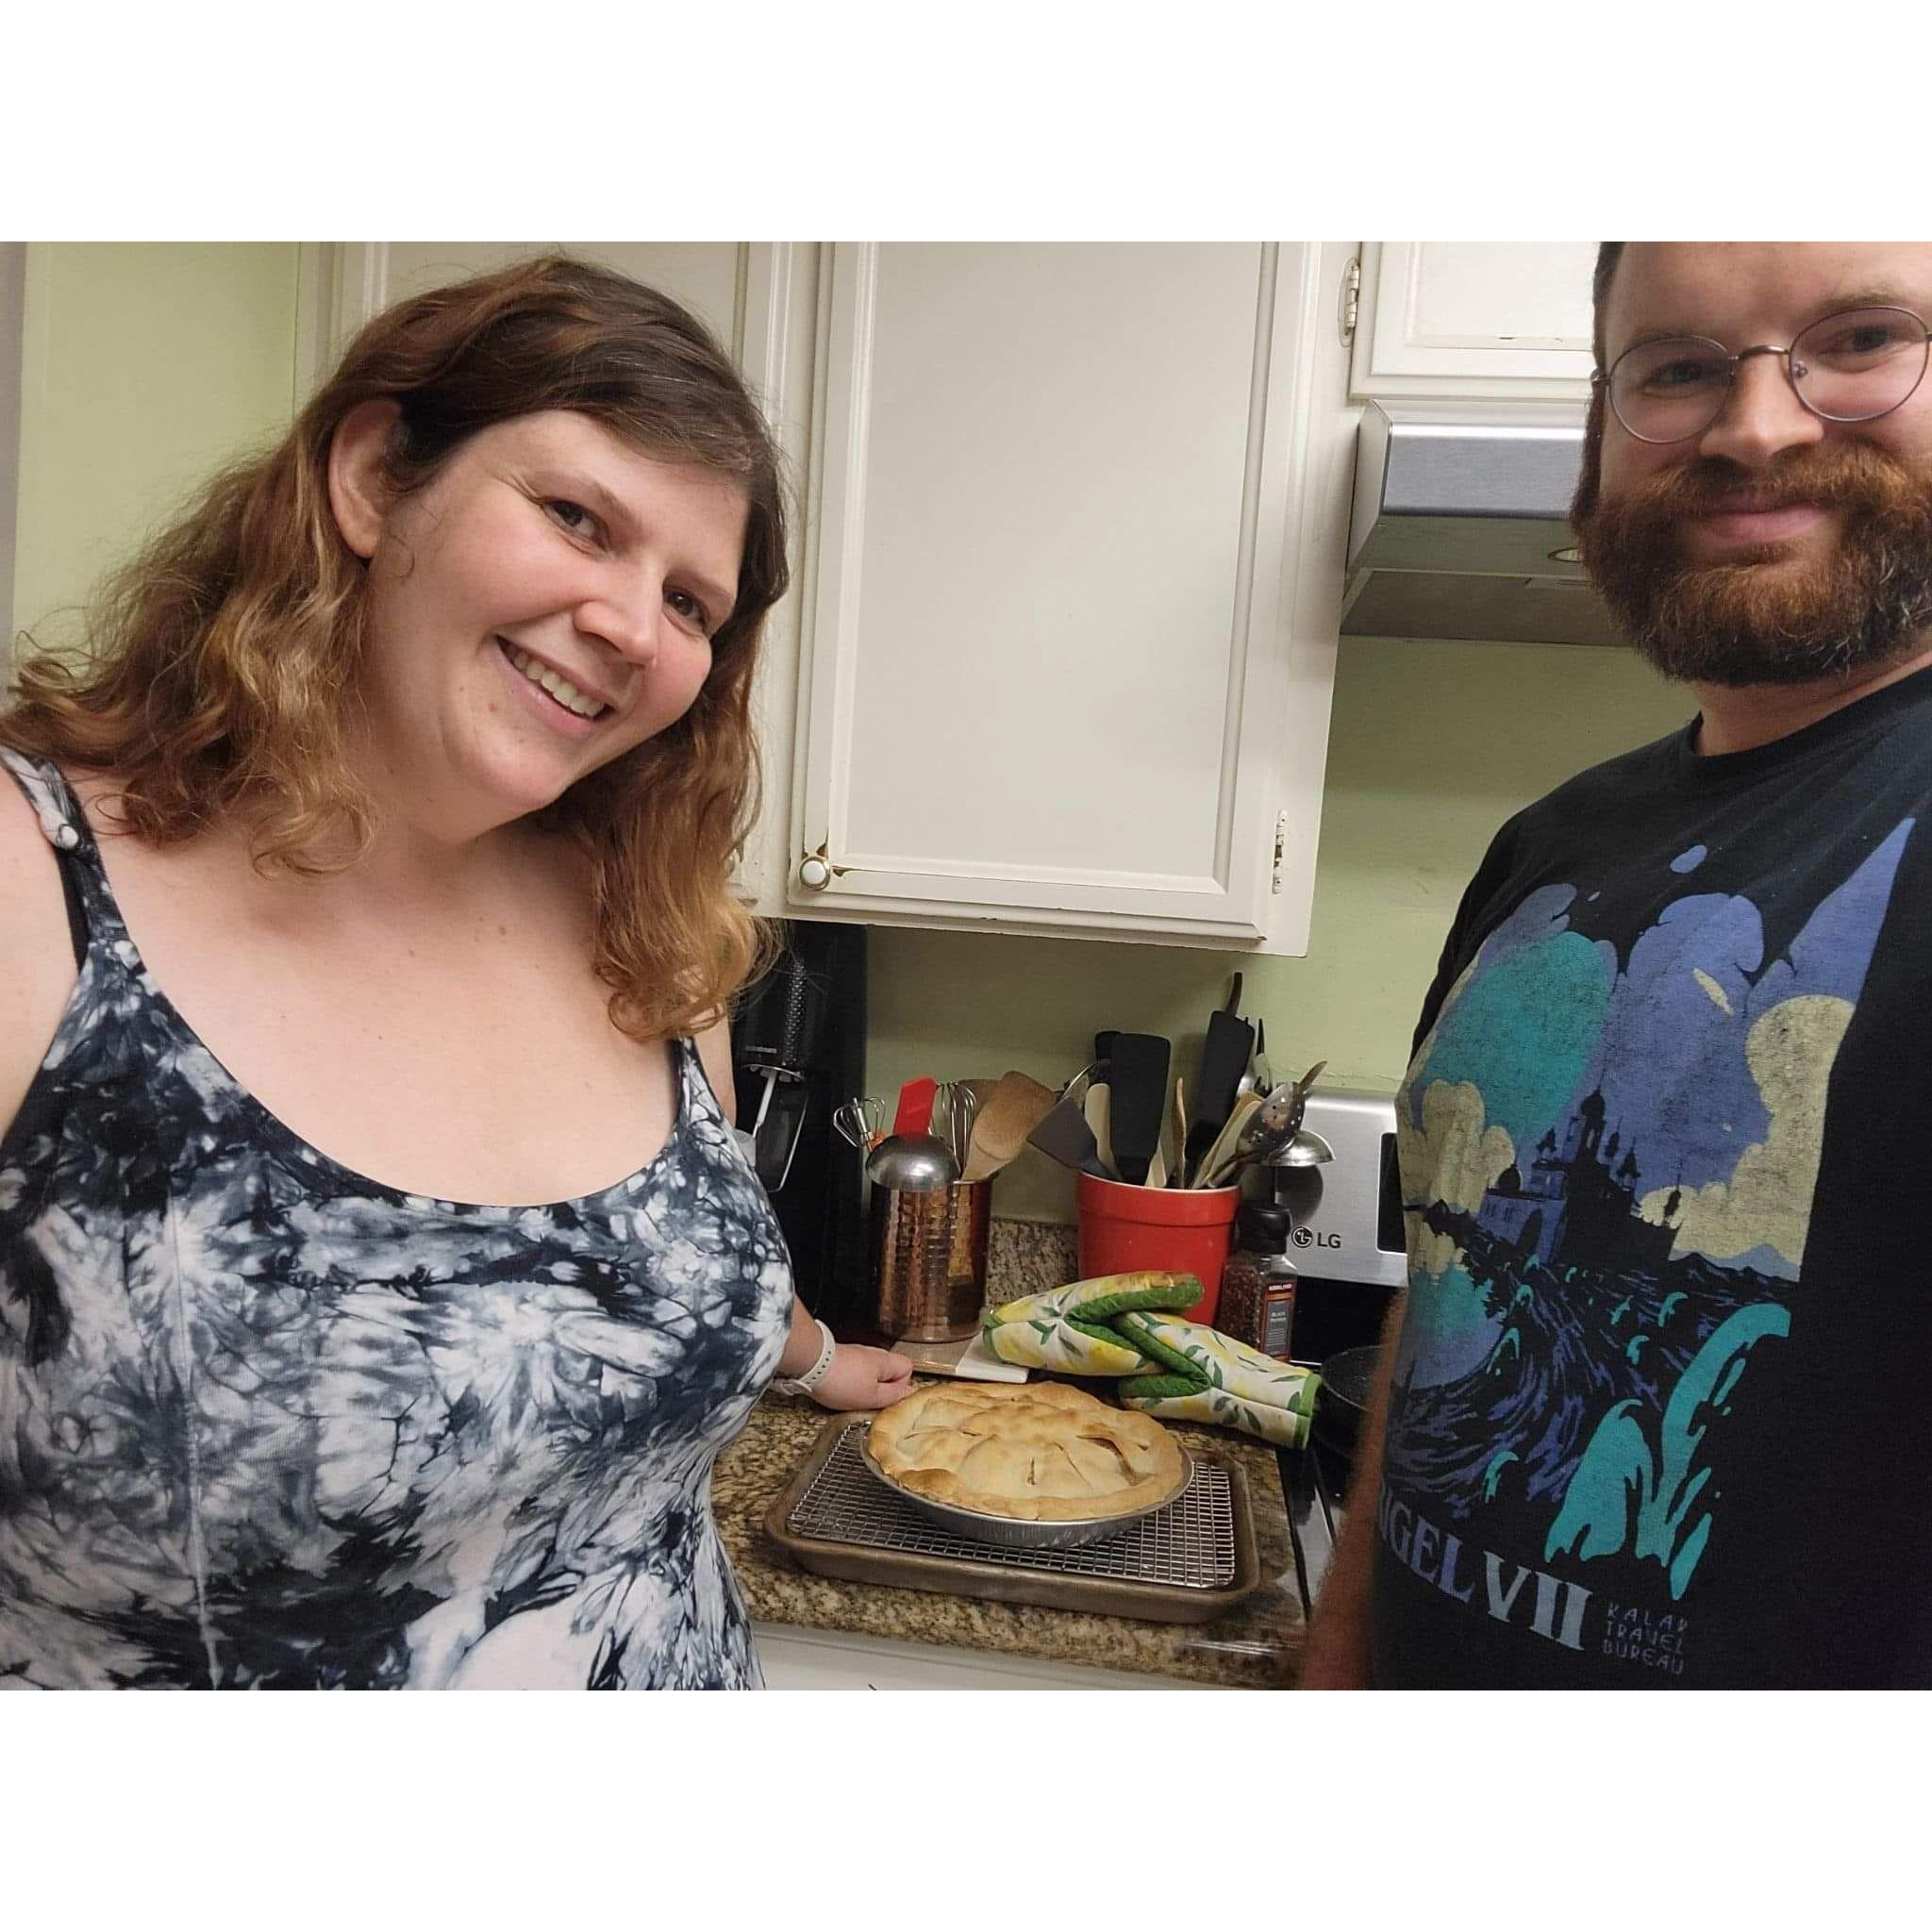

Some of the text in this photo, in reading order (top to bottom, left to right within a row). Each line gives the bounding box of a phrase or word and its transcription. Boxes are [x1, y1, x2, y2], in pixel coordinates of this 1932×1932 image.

[1317, 1232, 1341, 1249] LG
[1483, 1549, 1594, 1652] VII
[1607, 1621, 1683, 1655] TRAVEL
[1603, 1639, 1684, 1674] BUREAU
